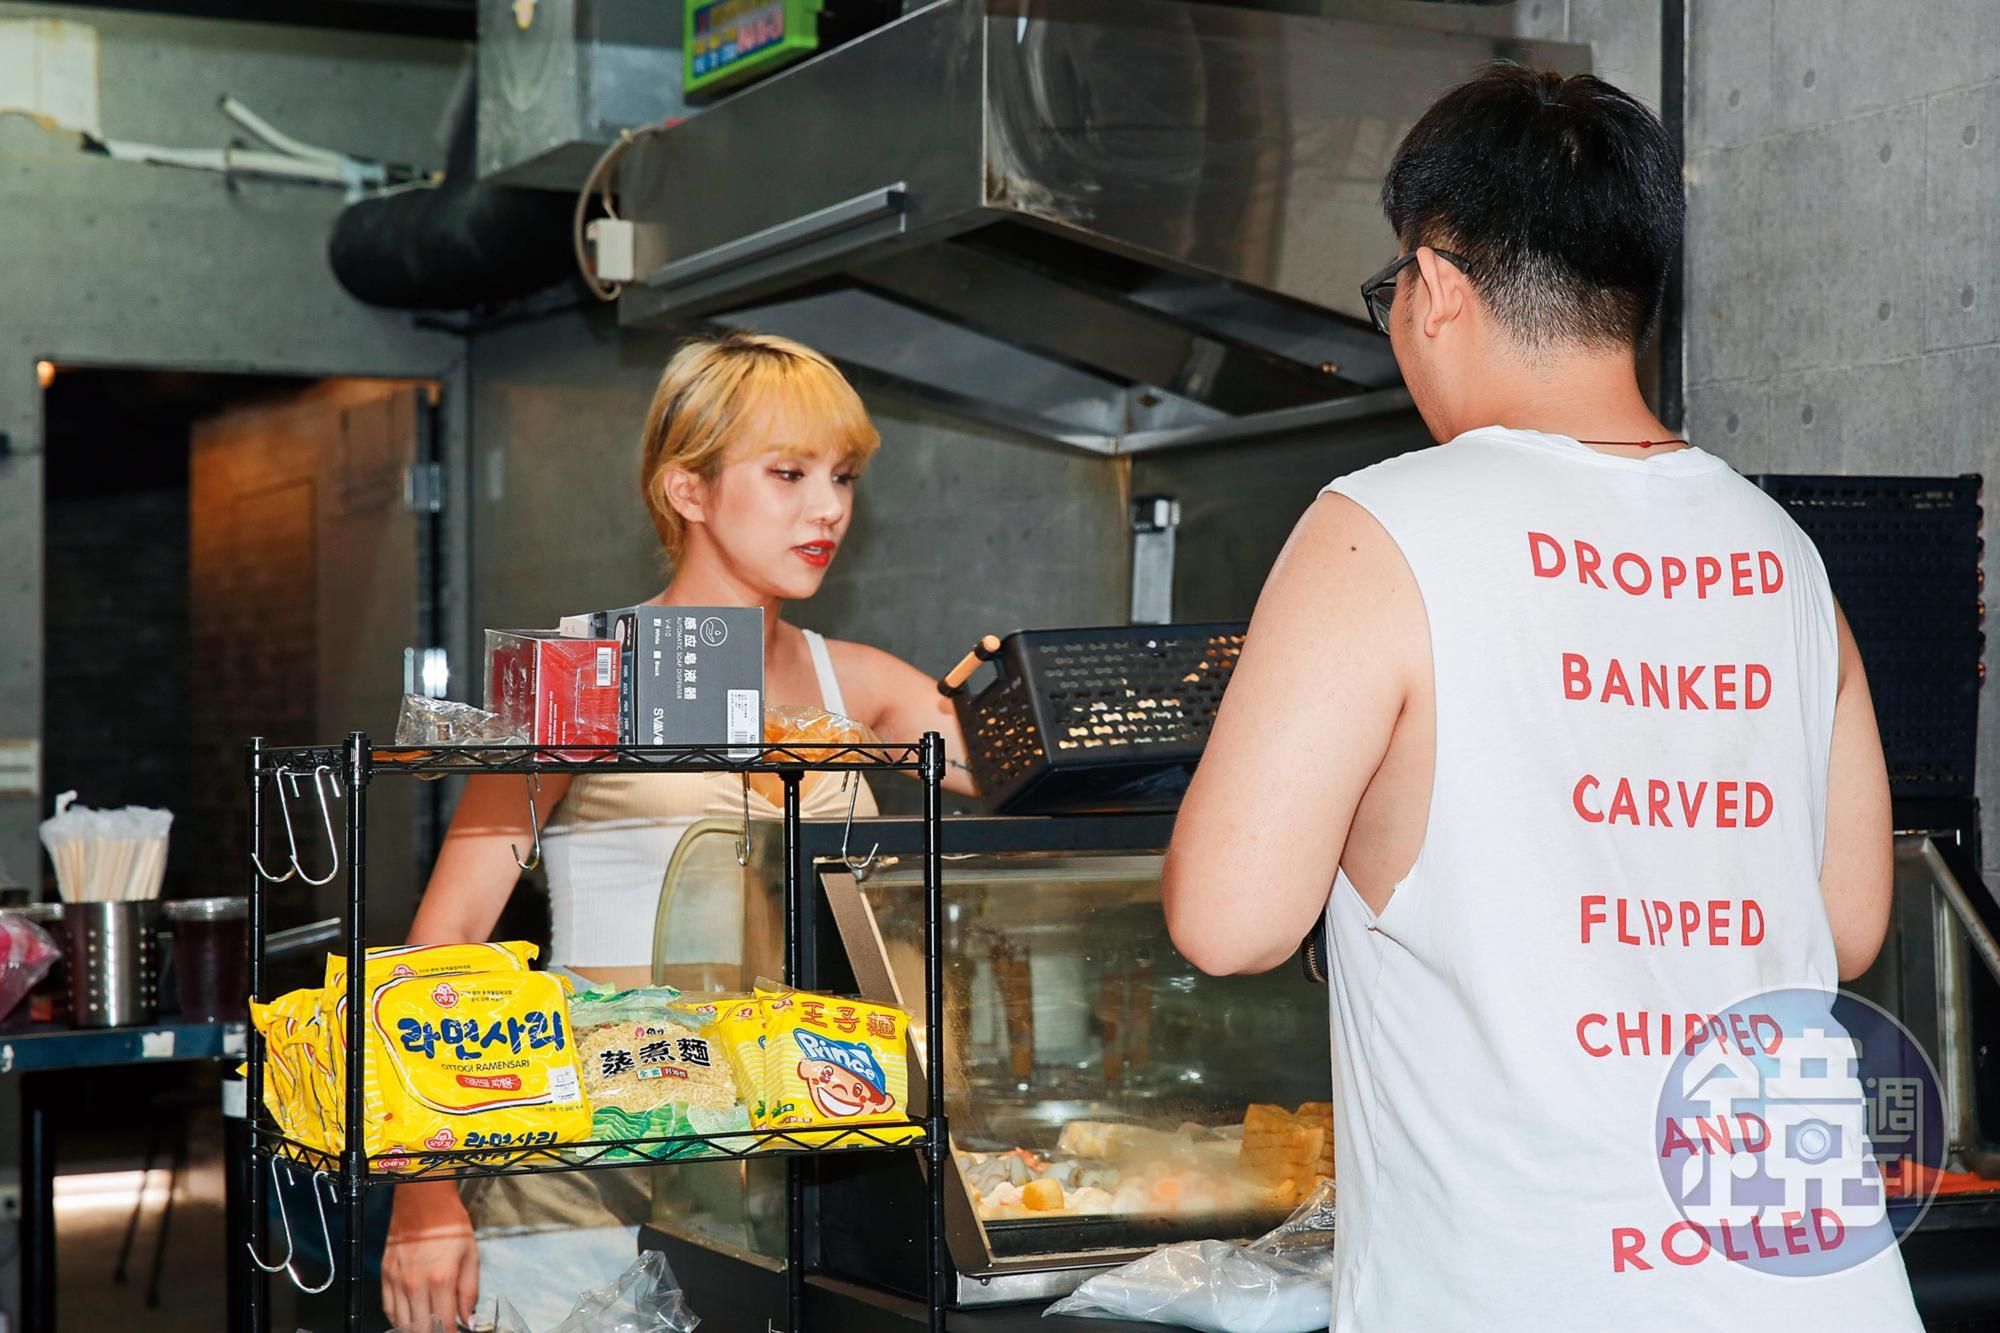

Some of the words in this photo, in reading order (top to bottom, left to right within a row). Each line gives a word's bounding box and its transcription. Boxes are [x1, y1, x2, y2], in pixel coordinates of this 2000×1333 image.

[1527, 530, 1785, 600] DROPPED
[684, 616, 697, 700] 感应皂液器
[1562, 652, 1772, 711] BANKED
[1572, 774, 1774, 829] CARVED
[1580, 895, 1765, 947] FLIPPED
[397, 1010, 565, 1060] 라면사리
[801, 1001, 898, 1040] 王子麵
[1575, 1012, 1784, 1057] CHIPPED
[441, 1063, 474, 1073] OTTOGI
[476, 1060, 530, 1072] RAMENSARI
[799, 1030, 877, 1080] Prince
[1660, 1111, 1772, 1158] AND
[1611, 1207, 1845, 1273] ROLLED
